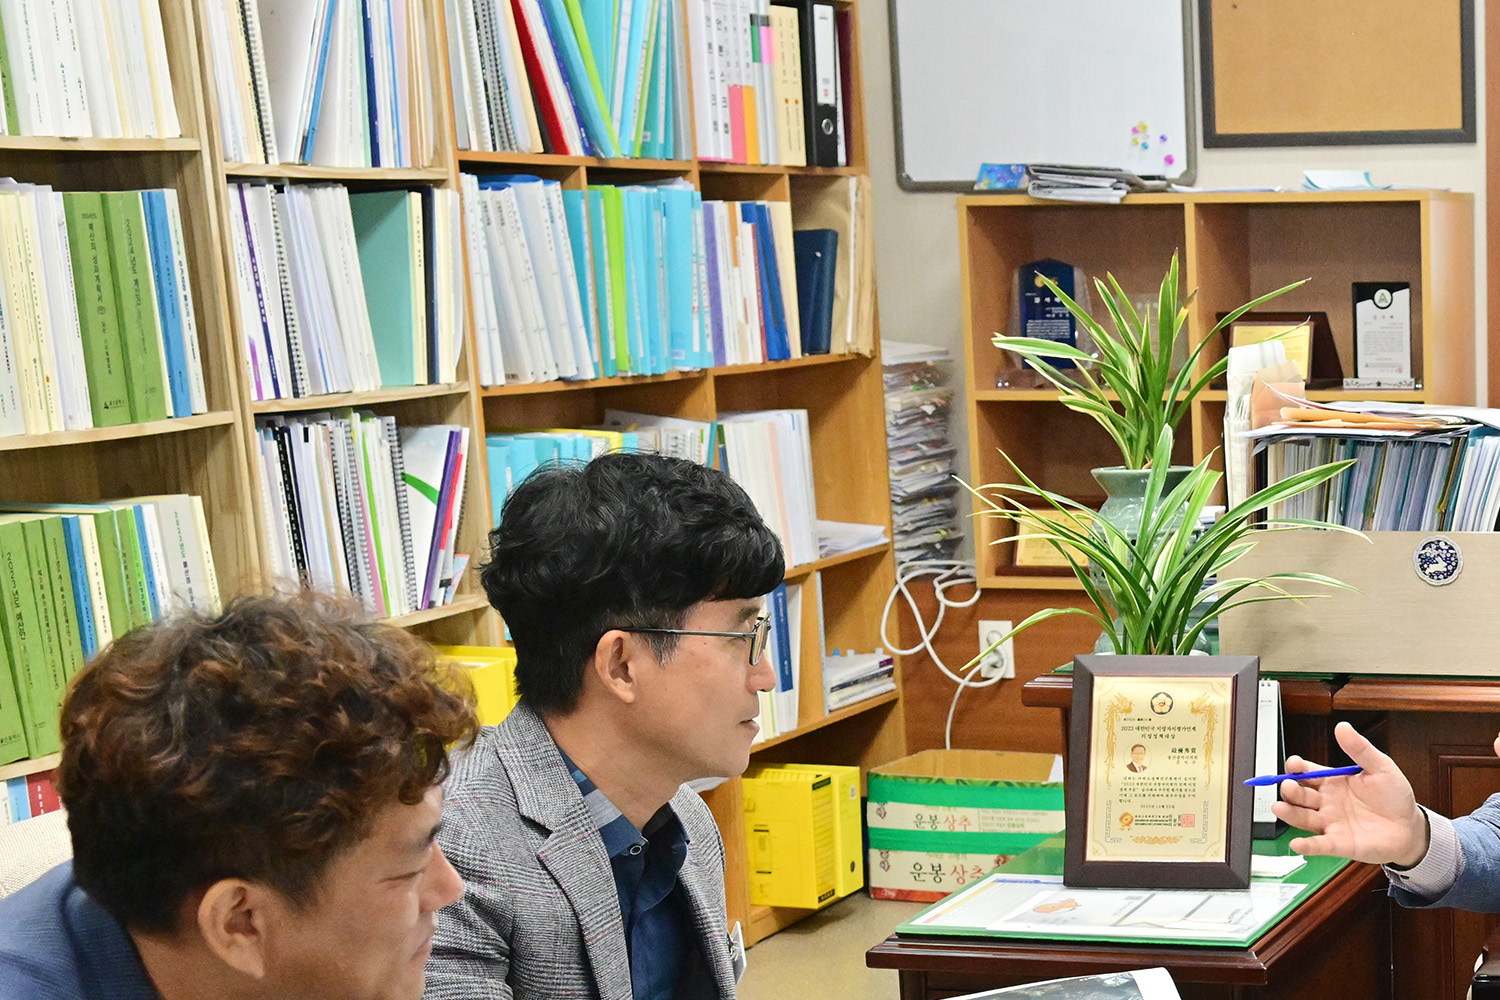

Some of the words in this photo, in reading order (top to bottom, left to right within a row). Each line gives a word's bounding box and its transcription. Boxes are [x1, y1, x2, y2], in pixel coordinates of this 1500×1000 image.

[913, 813, 941, 830] 운봉
[943, 814, 972, 832] 상추
[909, 862, 946, 884] 운봉
[950, 863, 985, 885] 상추
